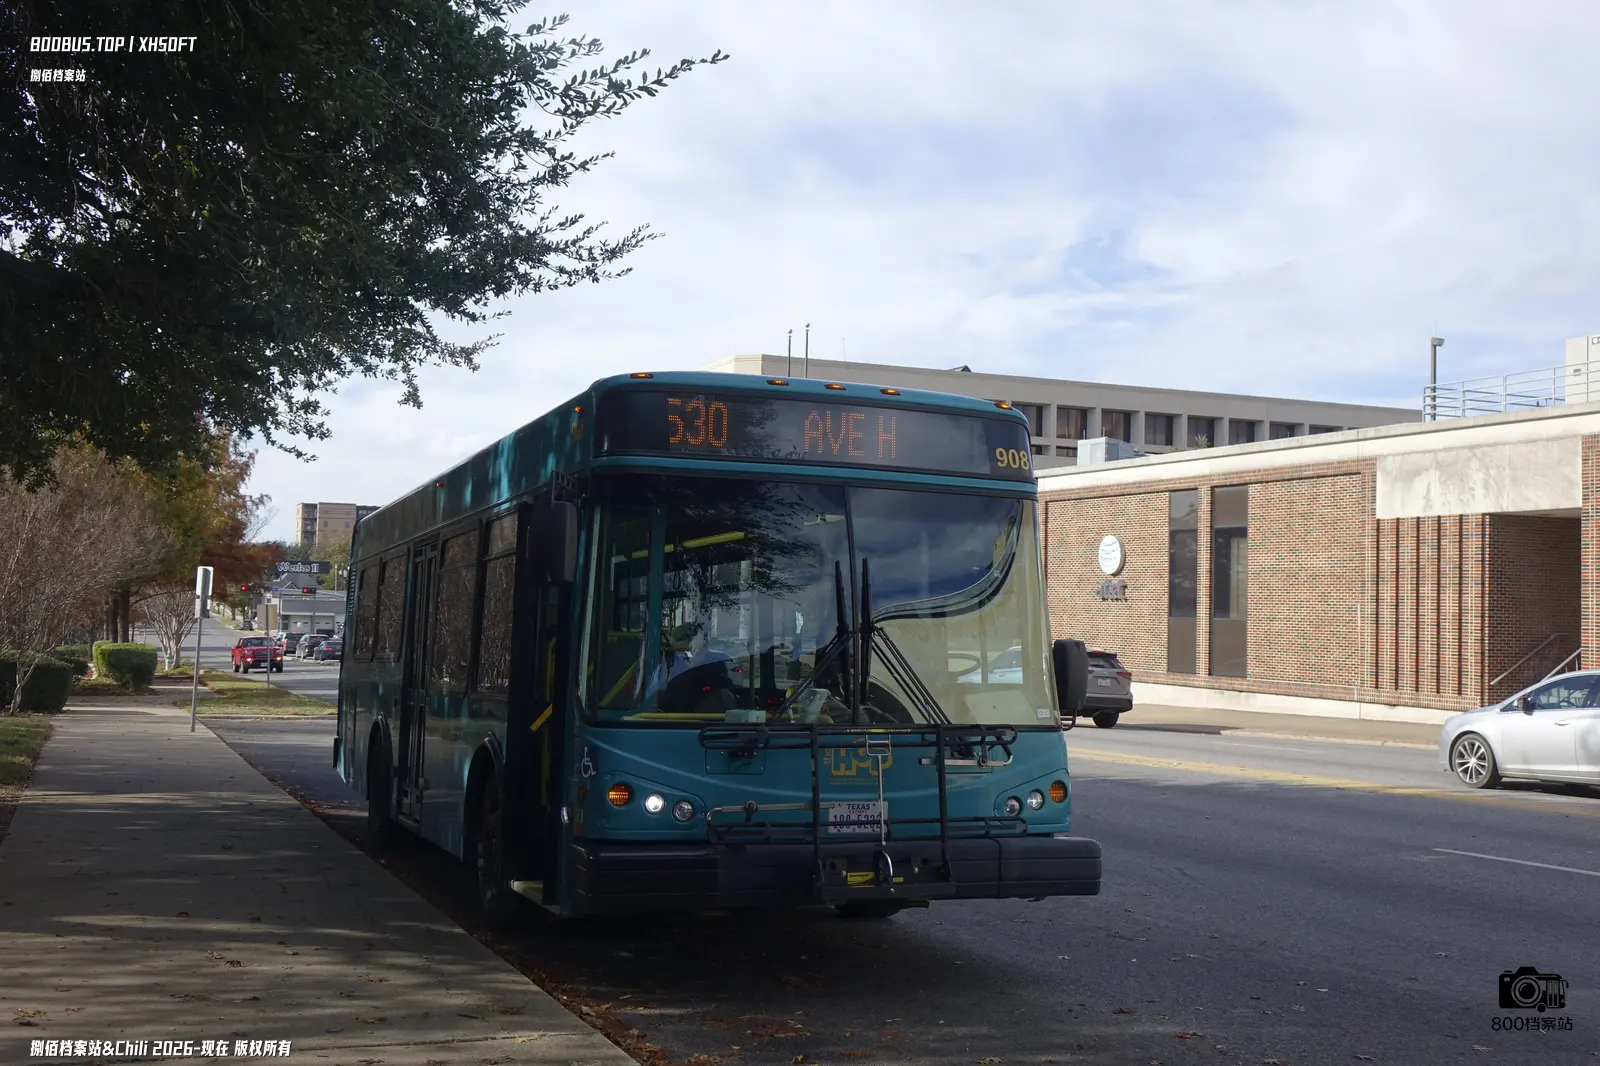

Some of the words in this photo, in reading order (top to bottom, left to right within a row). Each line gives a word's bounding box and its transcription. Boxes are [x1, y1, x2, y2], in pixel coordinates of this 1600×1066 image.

[667, 398, 728, 447] 530
[804, 410, 866, 456] AVE
[878, 415, 898, 459] H
[995, 447, 1030, 471] 908
[846, 803, 871, 811] TEXAS
